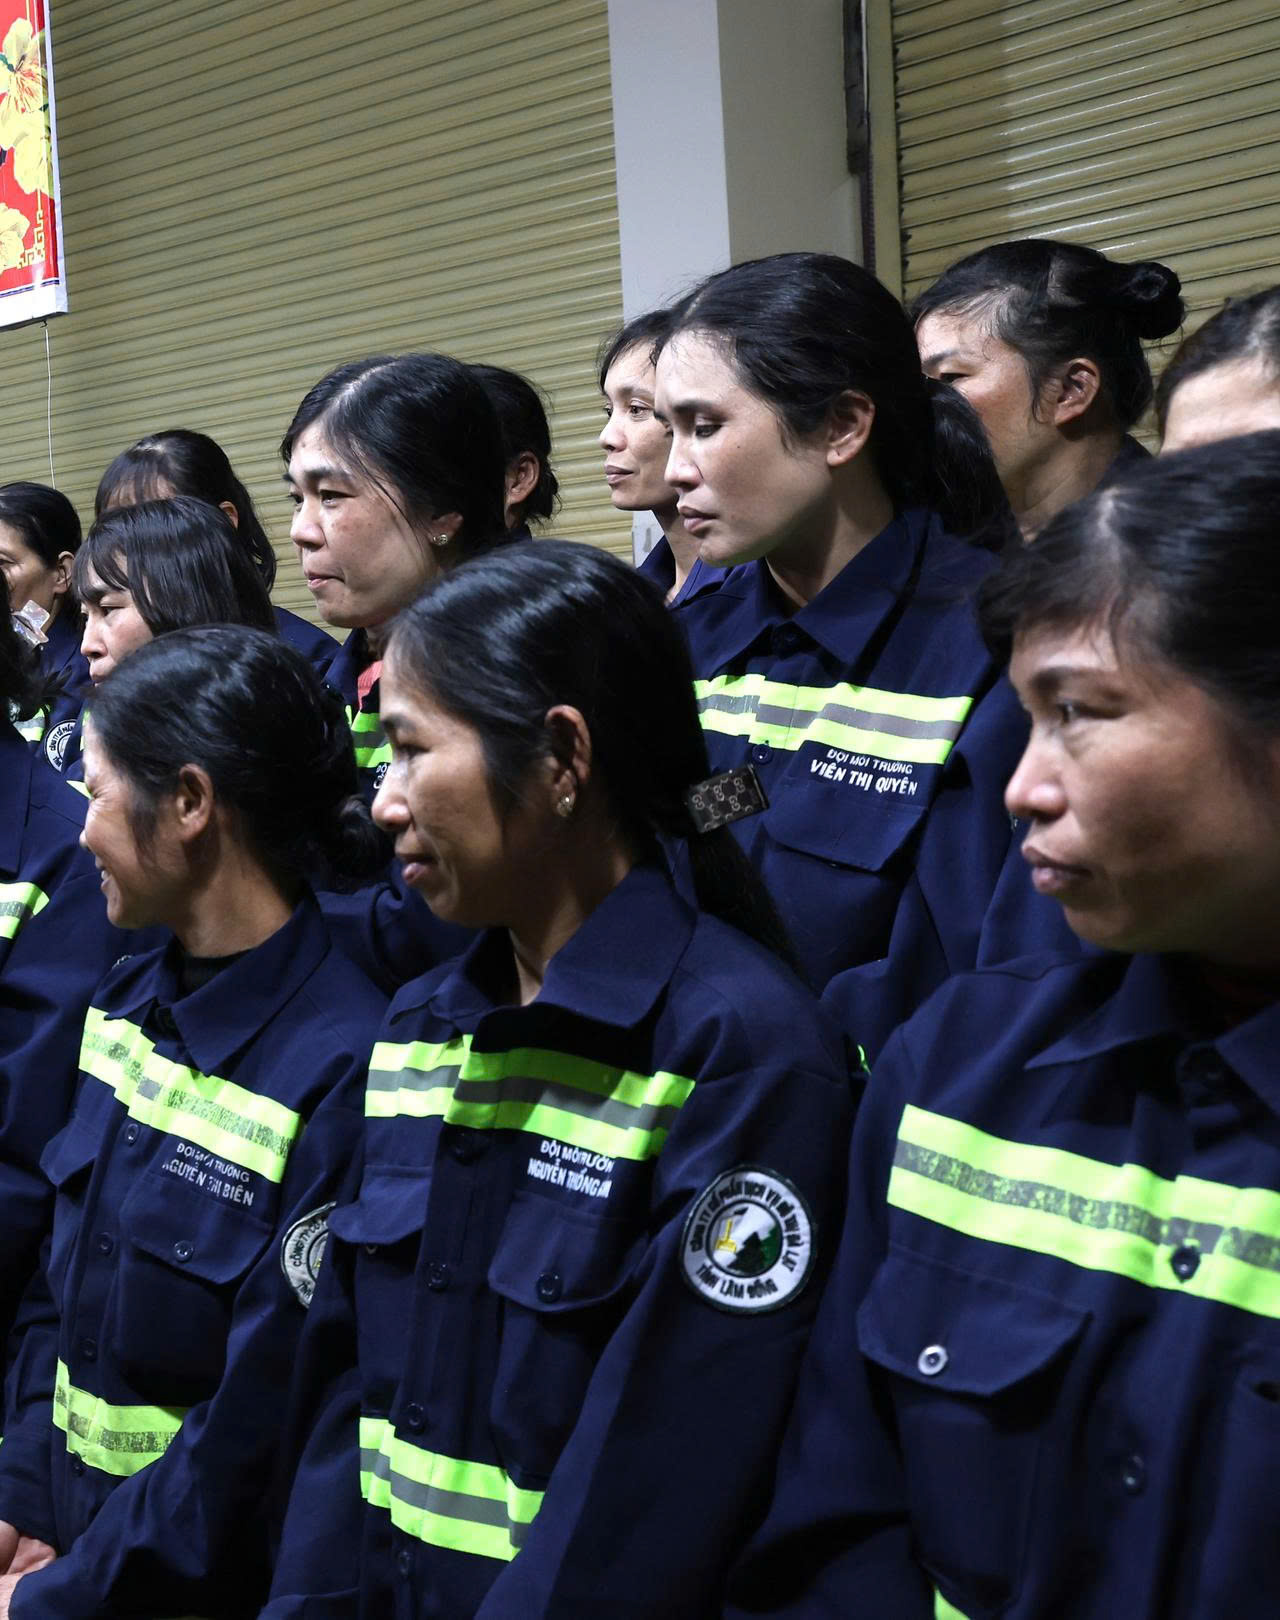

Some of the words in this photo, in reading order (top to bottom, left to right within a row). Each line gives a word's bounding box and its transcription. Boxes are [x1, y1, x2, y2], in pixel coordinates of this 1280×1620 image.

[810, 759, 847, 781] VIÊN
[848, 770, 874, 791] THỊ
[875, 776, 918, 796] QUYÊN
[540, 1139, 561, 1158] ĐỘI
